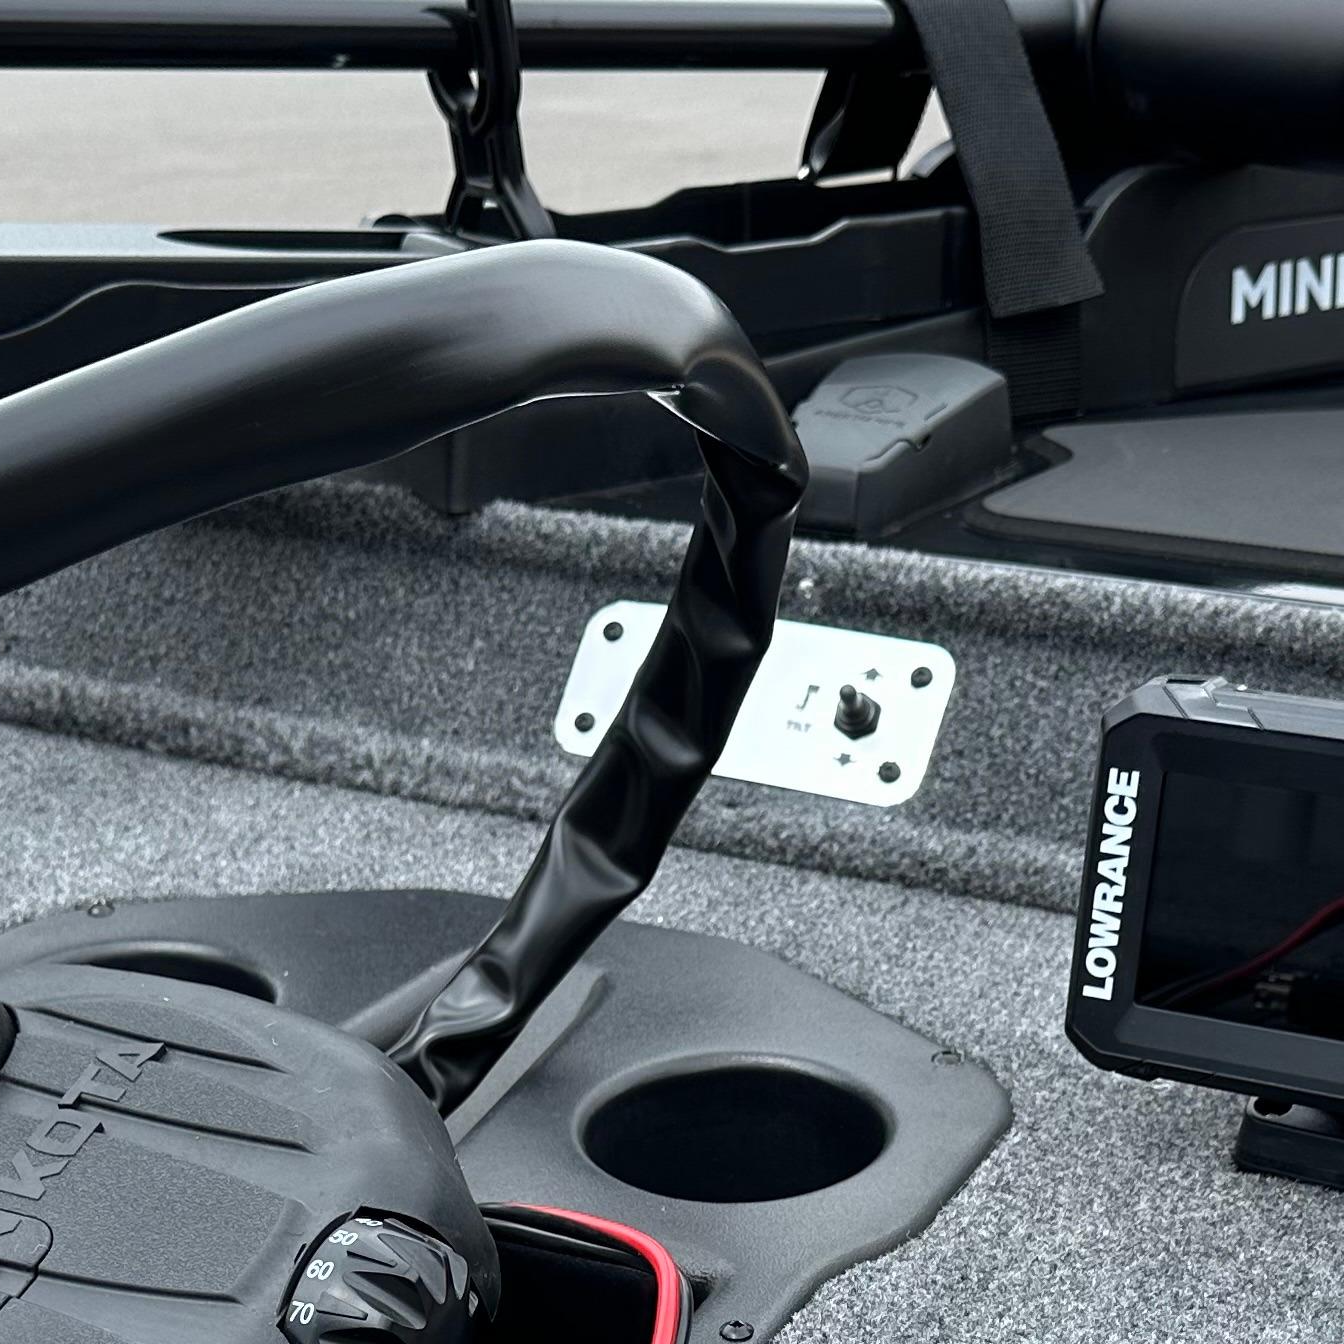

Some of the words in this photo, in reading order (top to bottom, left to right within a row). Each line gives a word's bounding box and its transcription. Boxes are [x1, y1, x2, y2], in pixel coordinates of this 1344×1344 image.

[1082, 767, 1140, 1001] LOWRANCE
[329, 1229, 358, 1246] 50
[306, 1259, 335, 1281] 60
[288, 1300, 315, 1325] 70
